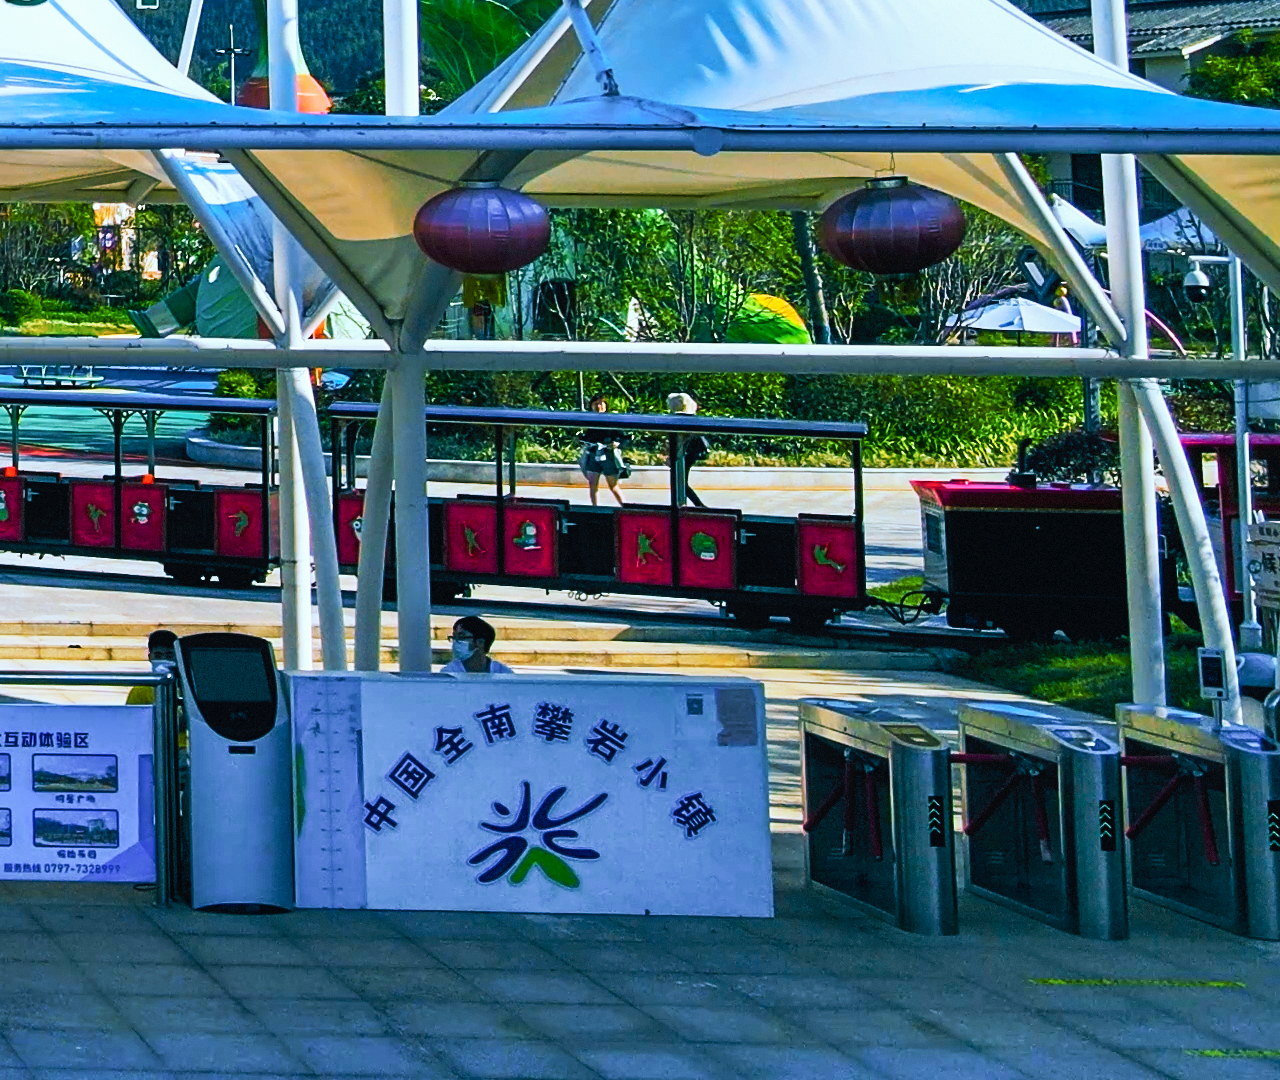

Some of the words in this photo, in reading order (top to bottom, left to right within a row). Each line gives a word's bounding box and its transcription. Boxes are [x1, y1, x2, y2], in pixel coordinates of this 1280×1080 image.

[363, 701, 716, 839] 中国全南攀岩小镇
